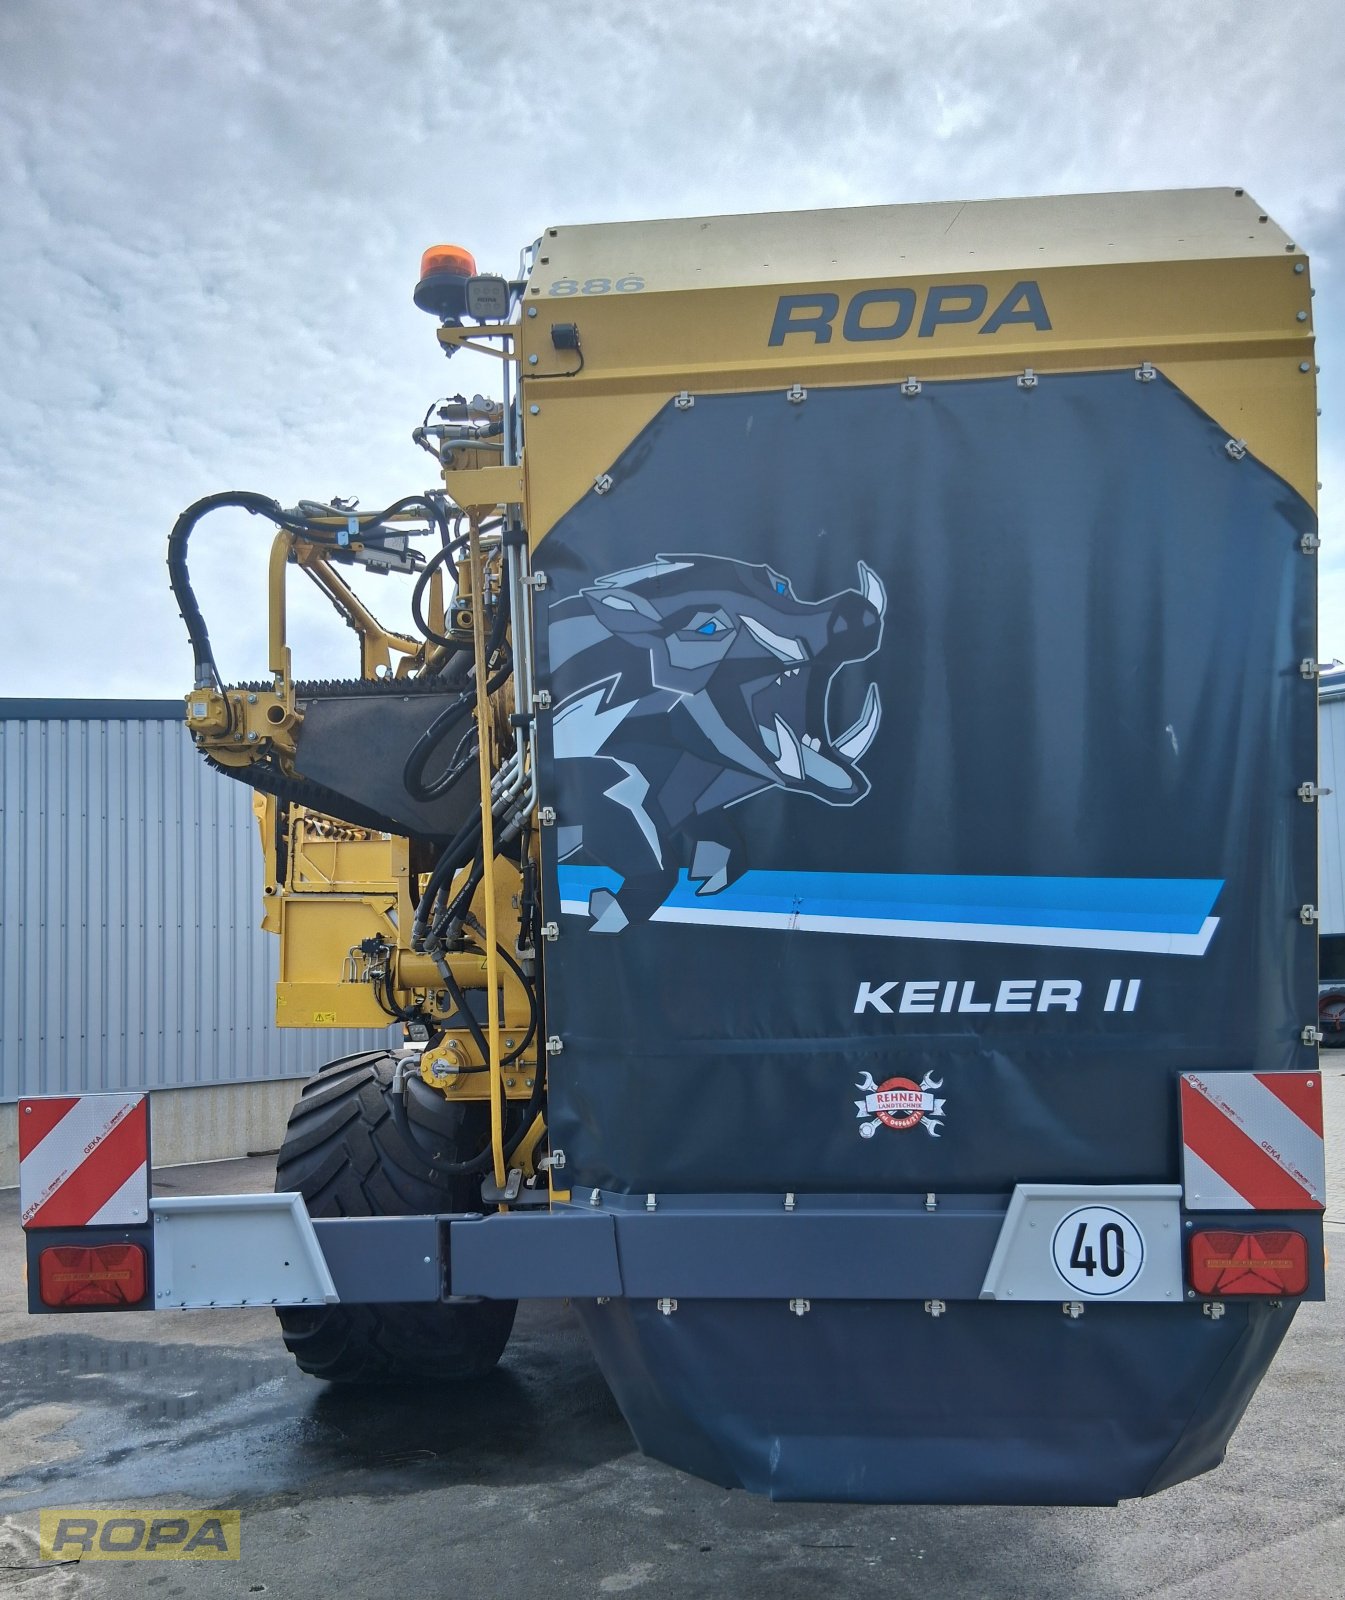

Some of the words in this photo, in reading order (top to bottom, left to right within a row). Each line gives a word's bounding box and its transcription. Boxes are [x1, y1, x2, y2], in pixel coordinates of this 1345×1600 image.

[548, 276, 645, 297] 886
[767, 280, 1053, 347] ROPA
[853, 979, 1083, 1014] KEILER
[1103, 979, 1141, 1012] II
[876, 1092, 923, 1103] REHNEN
[83, 1135, 102, 1154] GEKA
[1261, 1140, 1281, 1161] GEKA
[1069, 1222, 1125, 1277] 40
